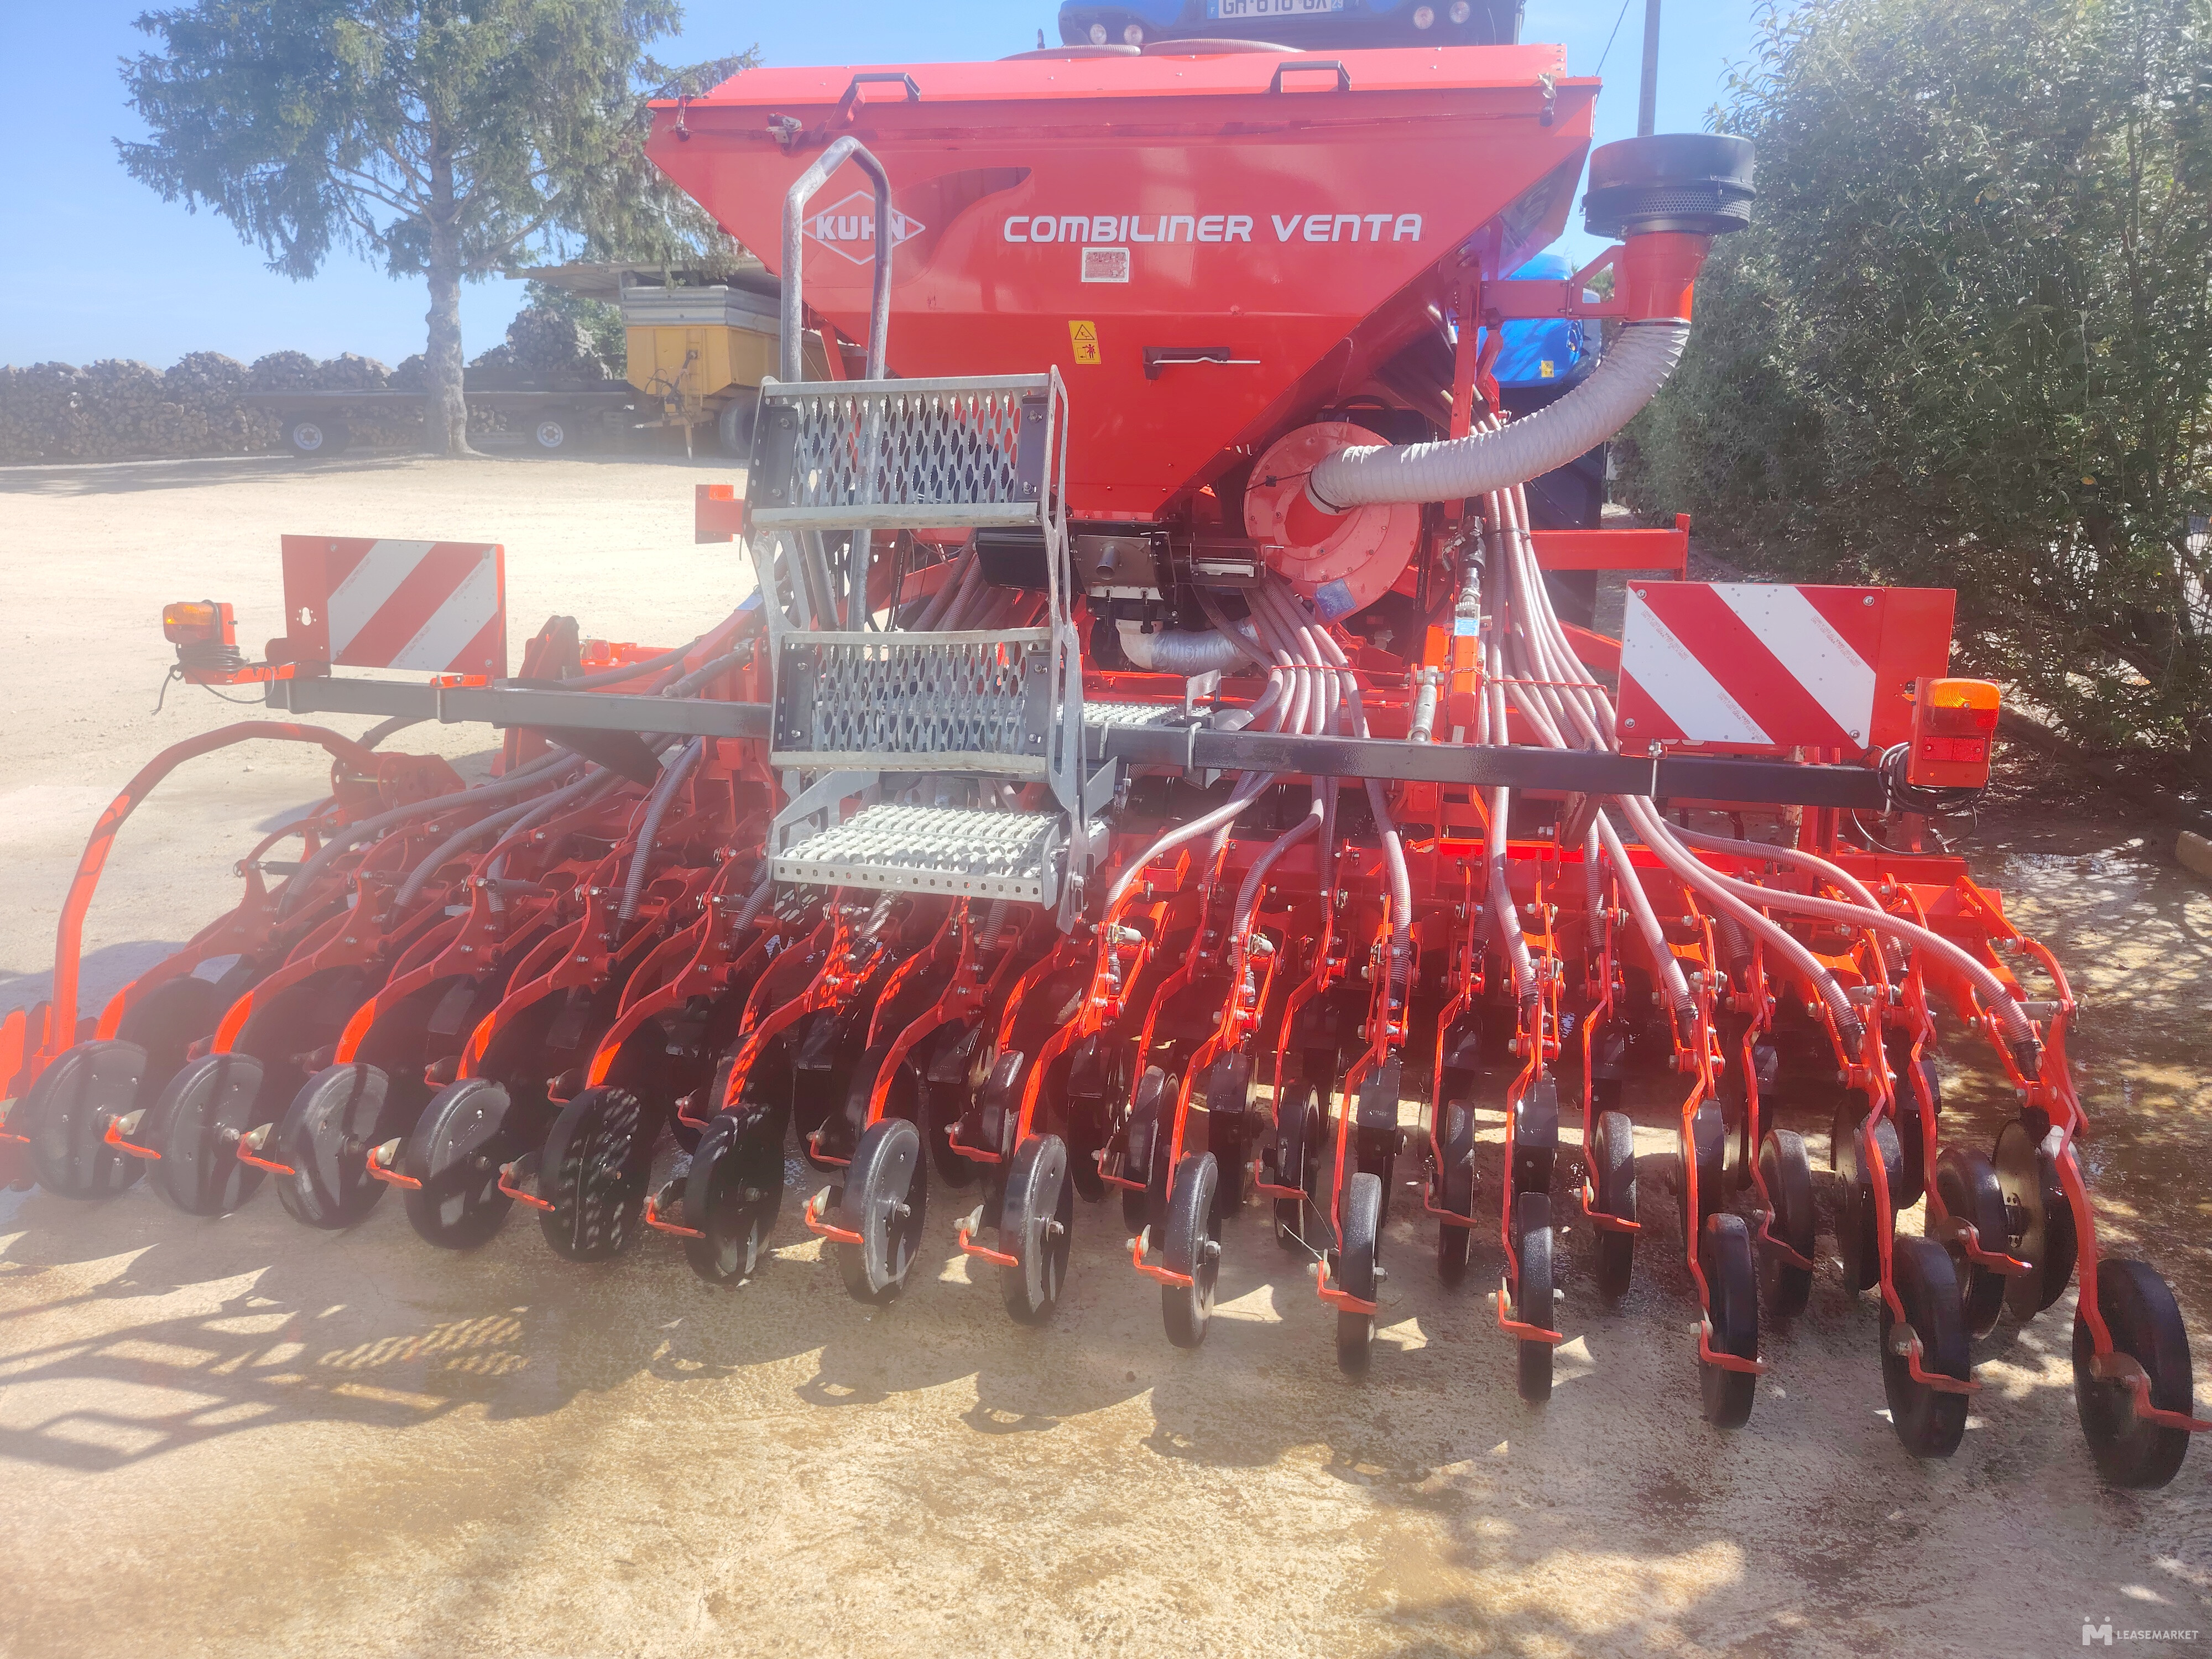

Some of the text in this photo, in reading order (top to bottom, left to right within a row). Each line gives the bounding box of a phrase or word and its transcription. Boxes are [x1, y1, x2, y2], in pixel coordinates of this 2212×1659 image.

[816, 216, 905, 240] KUHN
[1004, 214, 1422, 242] COMBILINER VENTA
